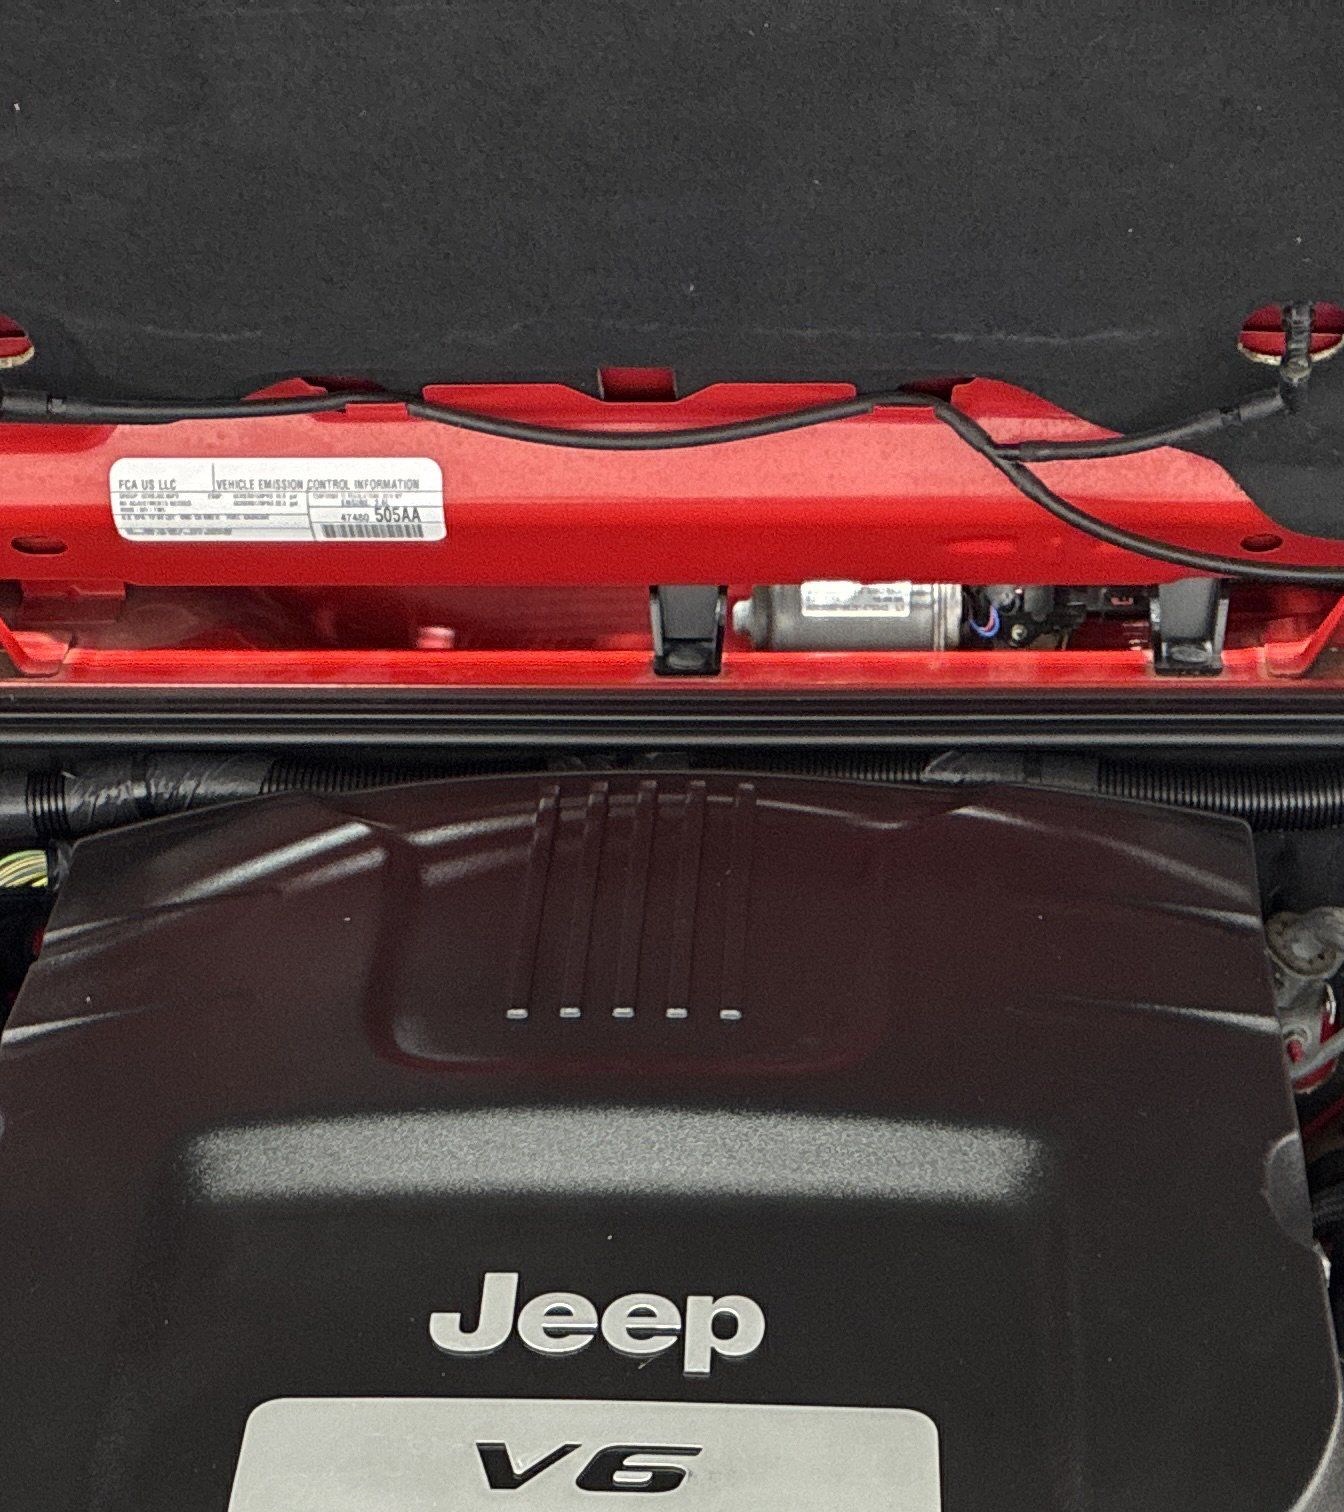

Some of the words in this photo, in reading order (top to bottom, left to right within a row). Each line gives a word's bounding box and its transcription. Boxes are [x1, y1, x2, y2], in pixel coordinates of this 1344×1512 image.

[118, 479, 137, 490] FCA
[141, 479, 155, 490] US
[158, 478, 176, 490] LLC
[216, 479, 254, 490] VEHICLE
[258, 479, 303, 490] EMISSION
[306, 479, 350, 490] CONTROL
[354, 479, 420, 490] INFORMATION
[374, 505, 422, 523] 505AA
[429, 1271, 767, 1376] Jeep
[474, 1440, 704, 1493] V6
